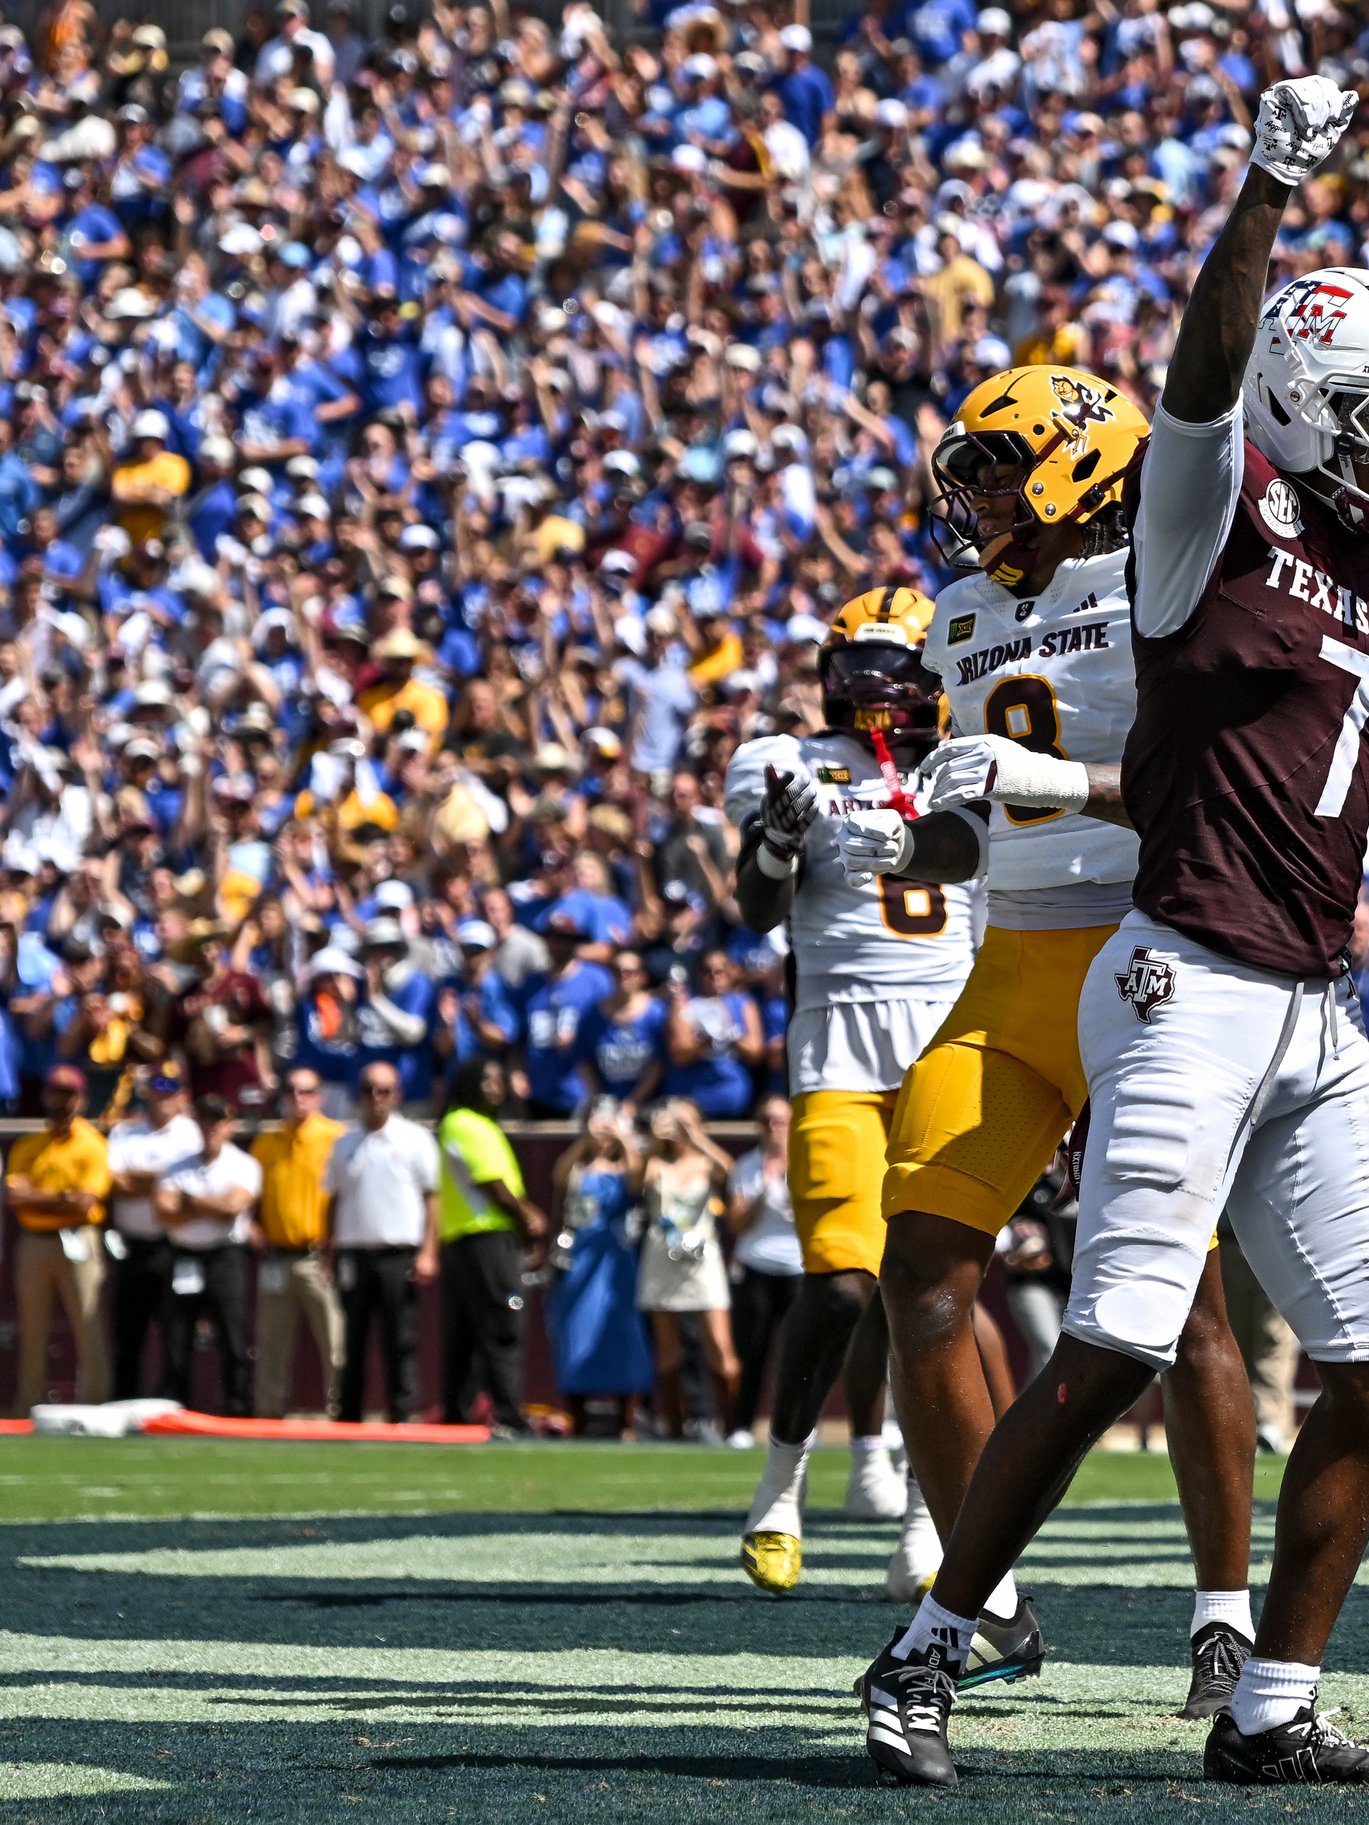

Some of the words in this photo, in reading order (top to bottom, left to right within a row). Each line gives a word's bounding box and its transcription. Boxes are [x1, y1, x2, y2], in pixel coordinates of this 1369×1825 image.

[1264, 120, 1287, 134] Aggies
[1268, 481, 1298, 524] SEC
[1038, 621, 1110, 658] STATE
